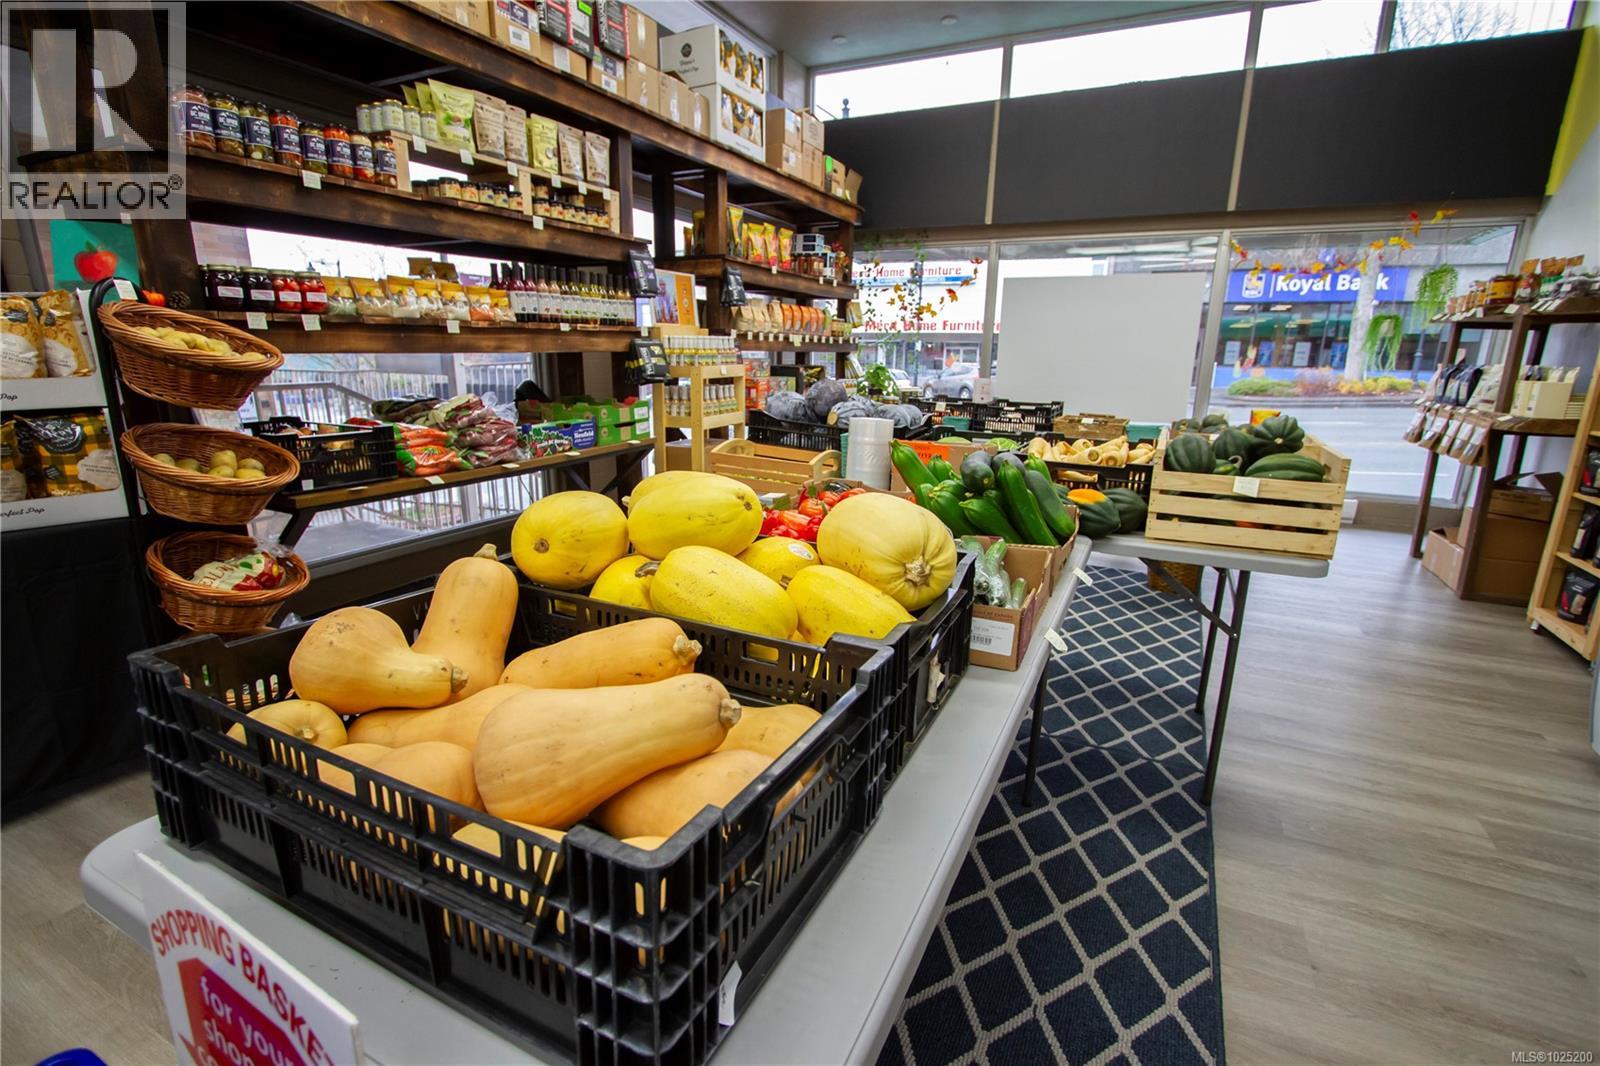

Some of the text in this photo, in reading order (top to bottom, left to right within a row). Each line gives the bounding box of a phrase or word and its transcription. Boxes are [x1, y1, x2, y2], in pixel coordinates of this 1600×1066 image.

[876, 267, 905, 277] Home
[910, 266, 962, 276] rniture
[1275, 273, 1390, 296] Royal Bak
[942, 320, 1002, 331] Furnite
[151, 909, 236, 966] SHOPPING
[201, 976, 232, 1025] for
